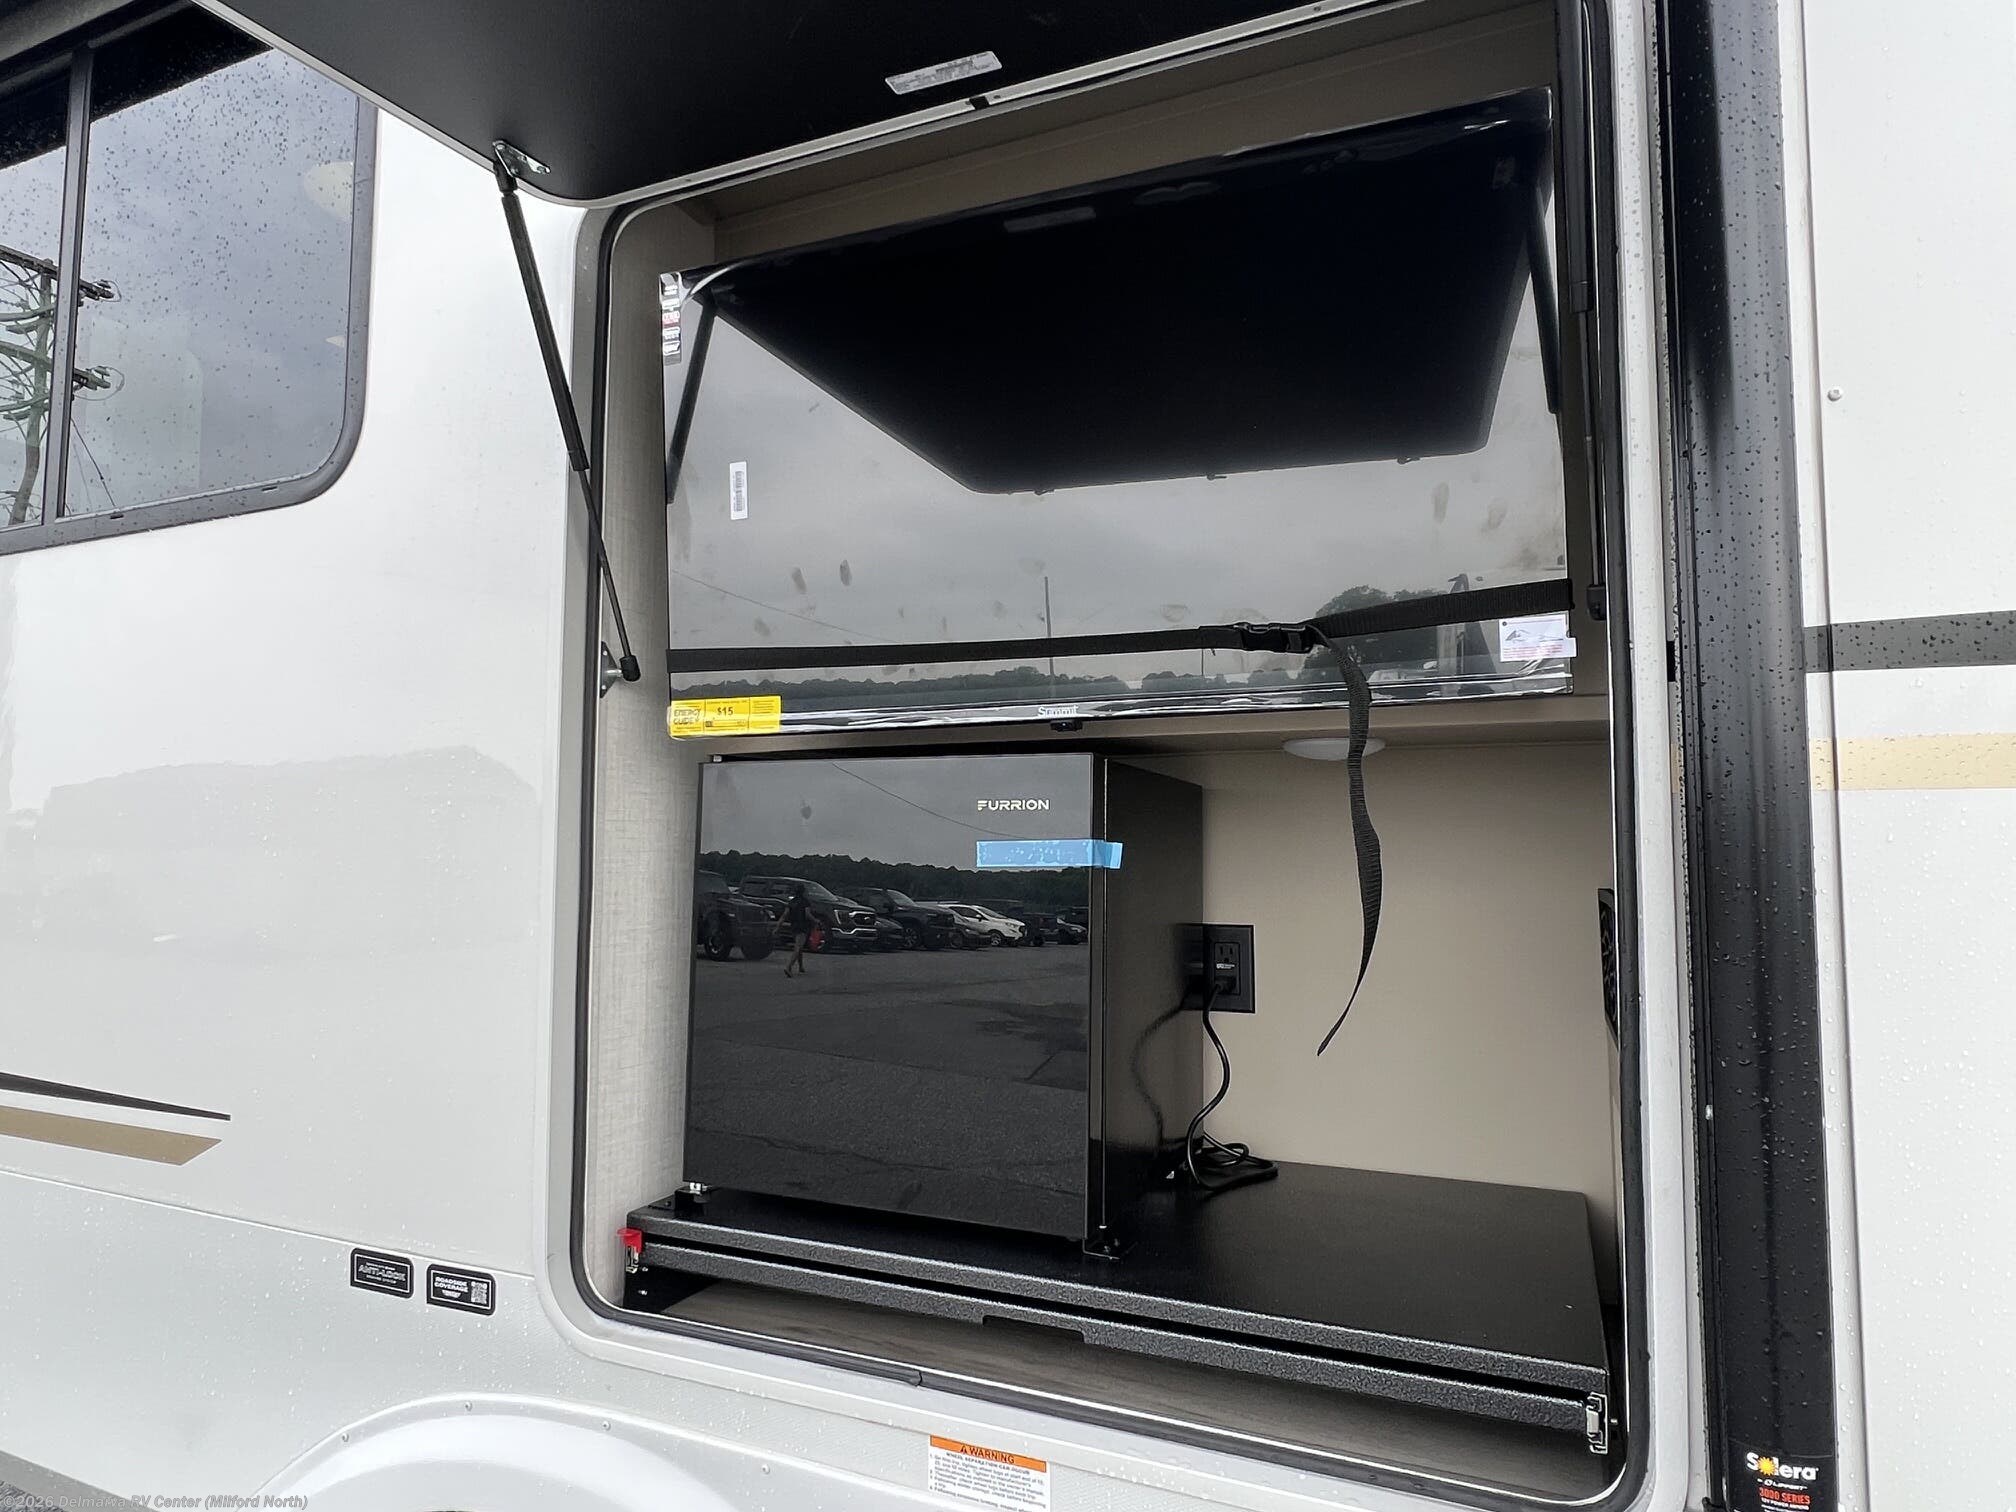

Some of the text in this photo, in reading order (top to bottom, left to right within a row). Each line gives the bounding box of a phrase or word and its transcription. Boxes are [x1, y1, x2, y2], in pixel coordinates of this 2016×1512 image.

[717, 706, 733, 716] $15
[977, 799, 1050, 812] FURRION
[969, 1446, 1014, 1464] WARNING
[1781, 1491, 1811, 1505] SERIES
